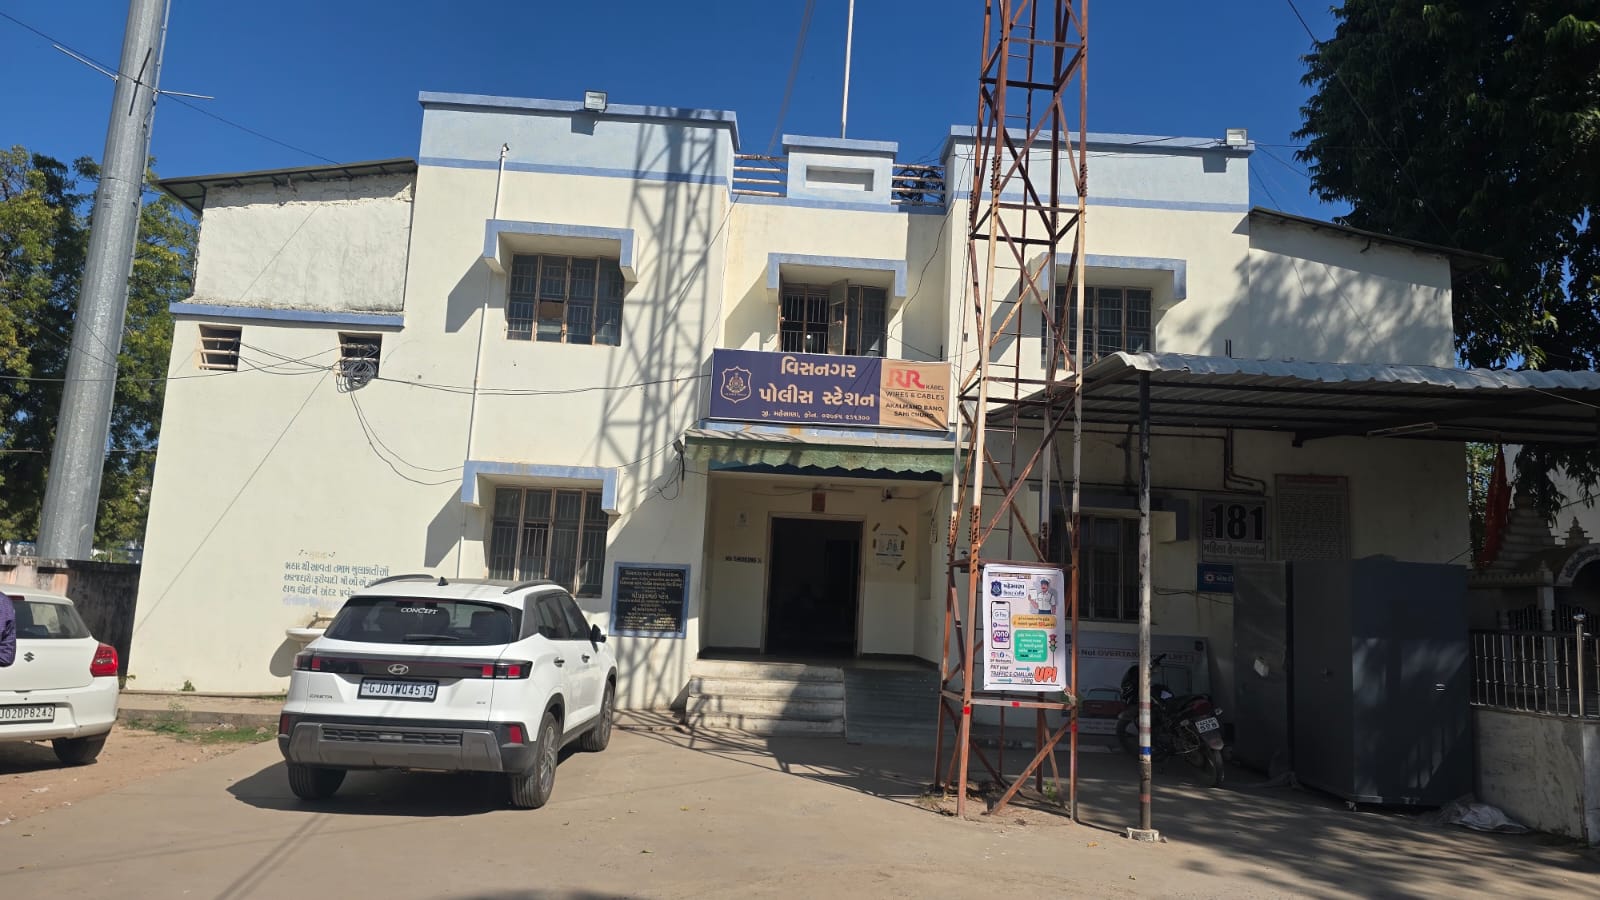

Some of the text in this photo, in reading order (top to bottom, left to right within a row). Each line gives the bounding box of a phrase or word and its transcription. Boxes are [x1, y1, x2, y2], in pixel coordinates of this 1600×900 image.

[780, 356, 856, 378] વિસનગર
[886, 368, 925, 389] RR
[758, 382, 875, 407] પોલીસ સ્ટેશન
[885, 391, 909, 399] WIRES
[1210, 503, 1263, 540] 181
[400, 606, 439, 616] CONCEPT
